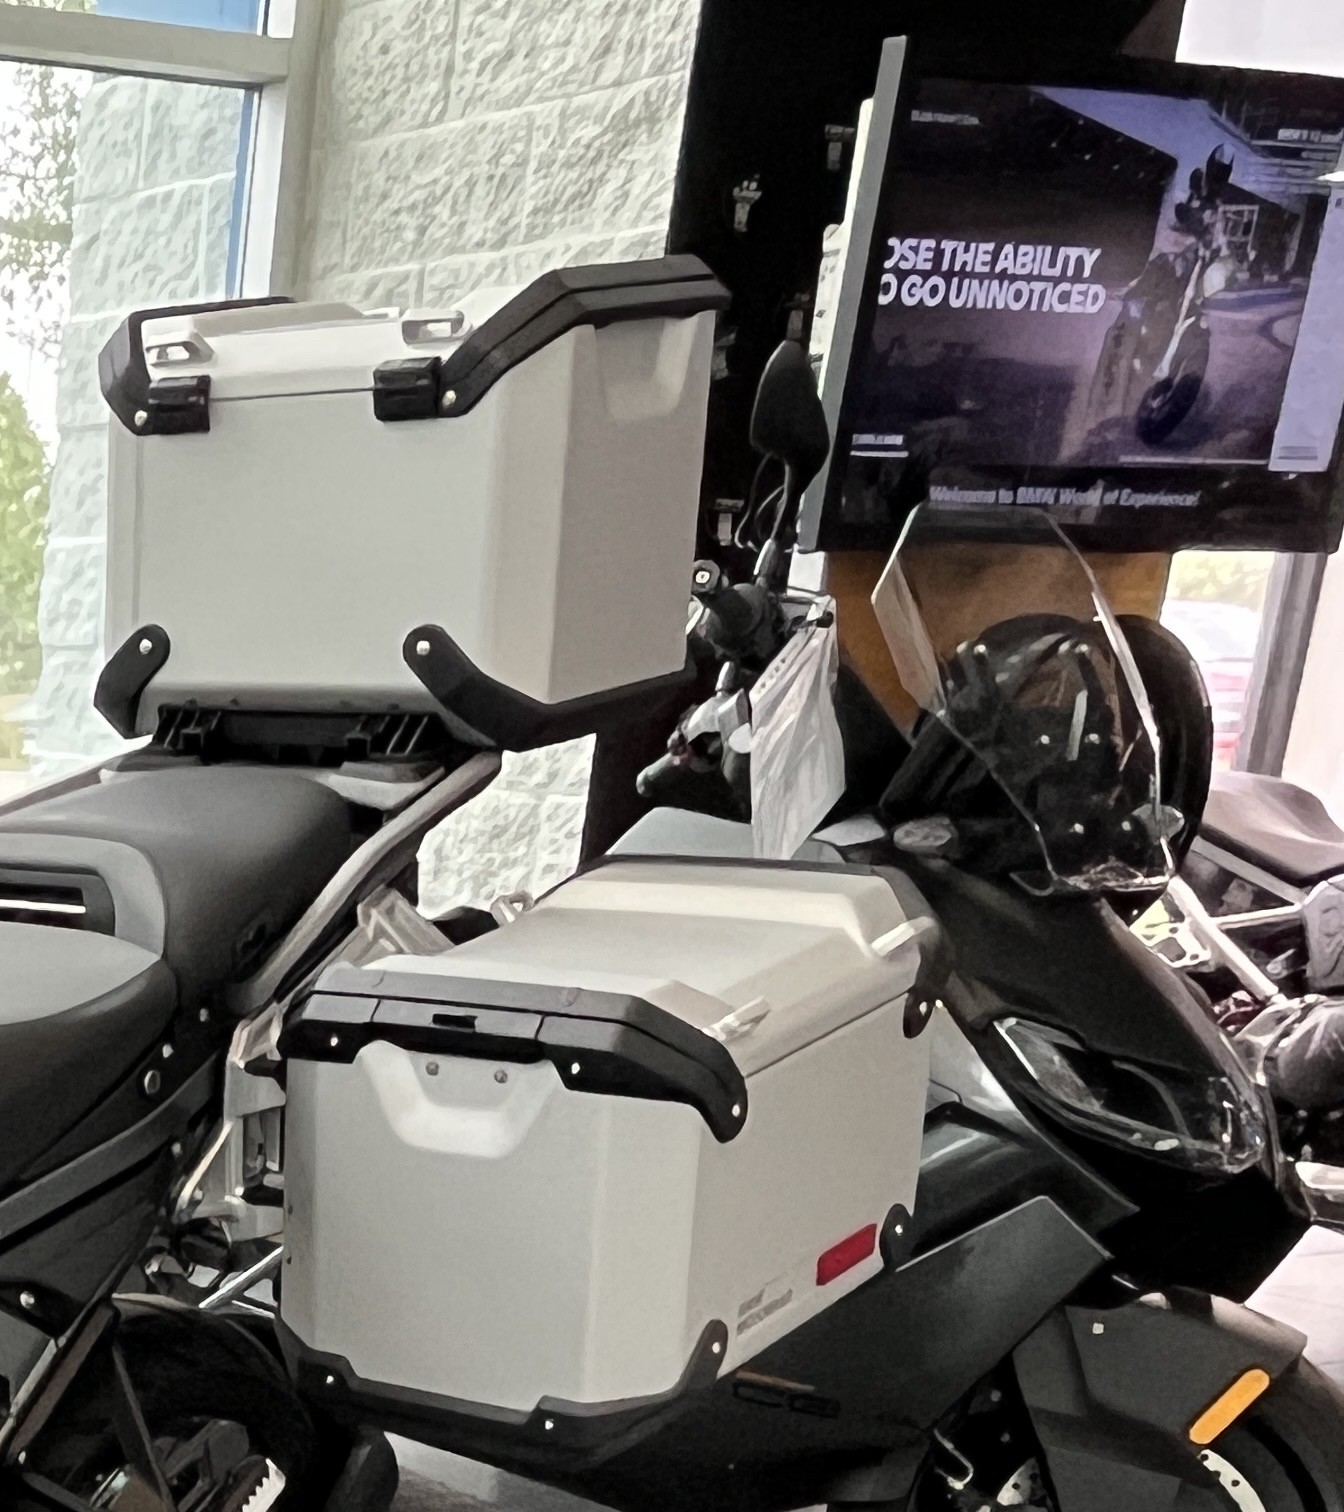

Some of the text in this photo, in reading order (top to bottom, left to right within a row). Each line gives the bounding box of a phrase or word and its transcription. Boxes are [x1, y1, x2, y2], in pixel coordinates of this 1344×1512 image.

[940, 239, 995, 273] THE
[995, 242, 1102, 278] ABILITY
[900, 275, 947, 307] GO
[948, 277, 1107, 313] UNNOTICED
